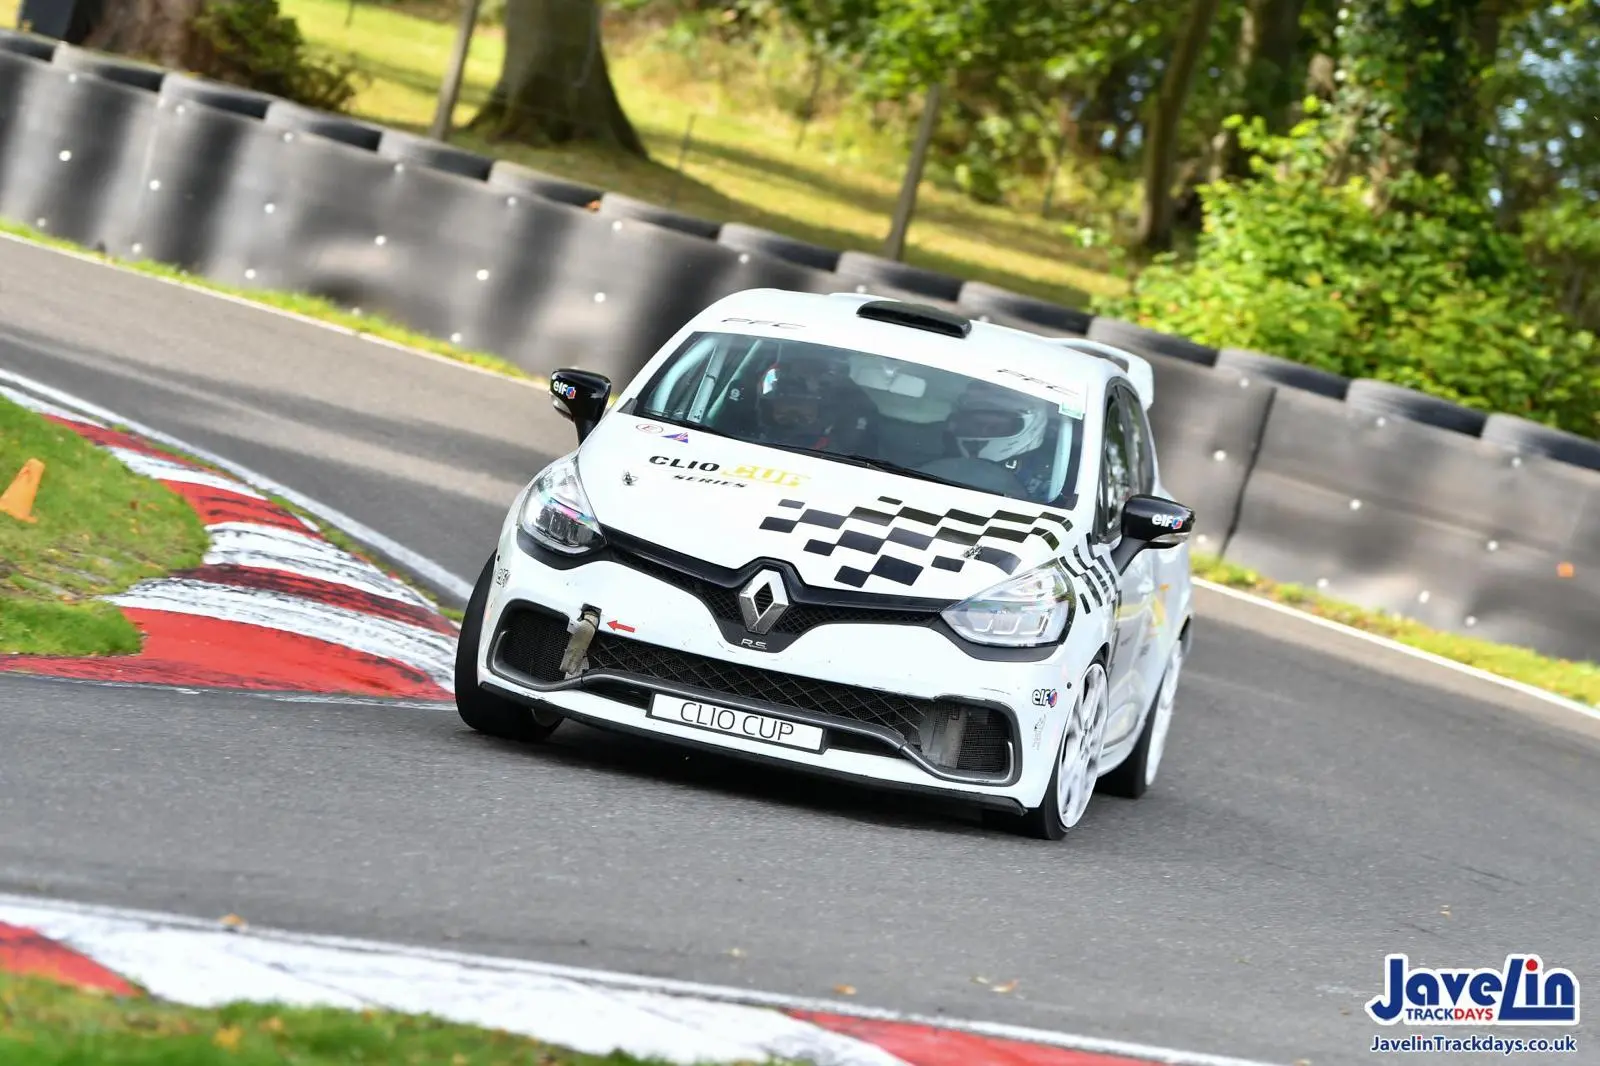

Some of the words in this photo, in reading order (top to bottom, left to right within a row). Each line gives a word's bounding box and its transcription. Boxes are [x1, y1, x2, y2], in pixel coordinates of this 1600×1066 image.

[553, 380, 569, 395] elf
[649, 455, 720, 473] CLIO
[672, 474, 748, 489] SERIES
[1152, 513, 1173, 527] elf
[680, 701, 736, 730] CLIO
[742, 715, 794, 741] CUP
